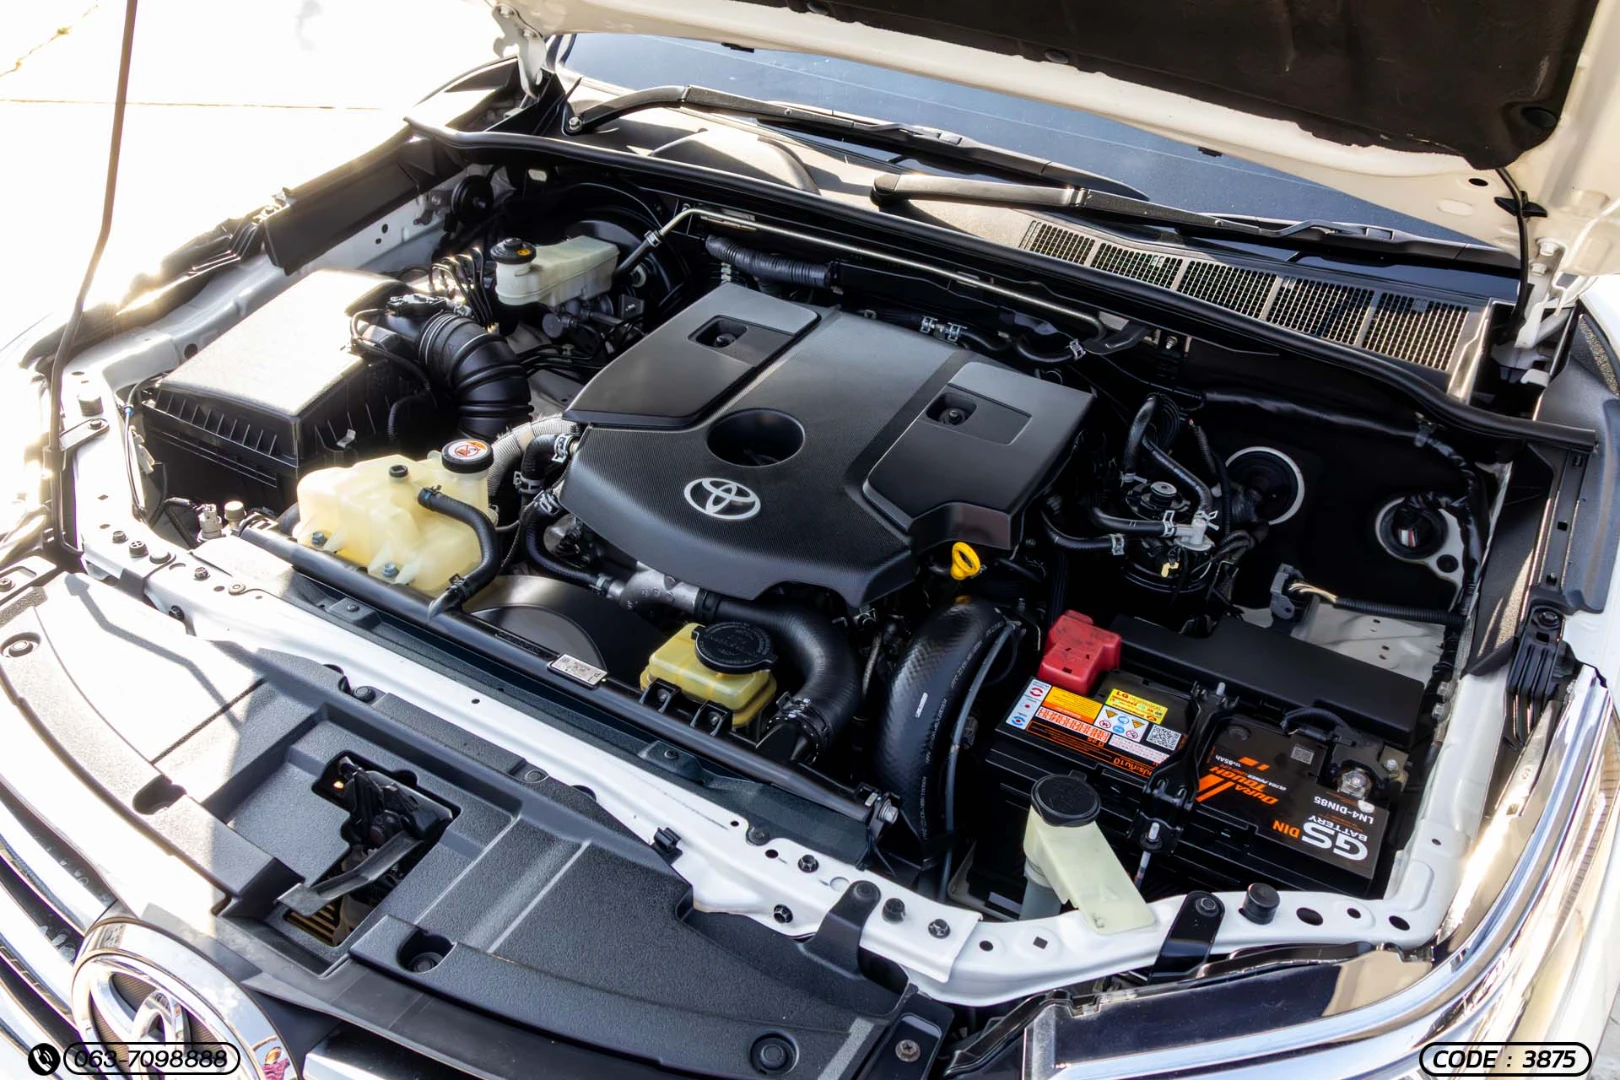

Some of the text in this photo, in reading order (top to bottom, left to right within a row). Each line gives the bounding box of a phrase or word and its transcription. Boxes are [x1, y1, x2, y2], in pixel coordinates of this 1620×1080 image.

[1209, 765, 1267, 792] TOUGH
[1235, 784, 1279, 805] DURA
[1313, 795, 1374, 825] LN4-DIN85
[1272, 819, 1300, 839] DIN
[1301, 821, 1368, 861] GS
[1308, 814, 1368, 842] BATTERY
